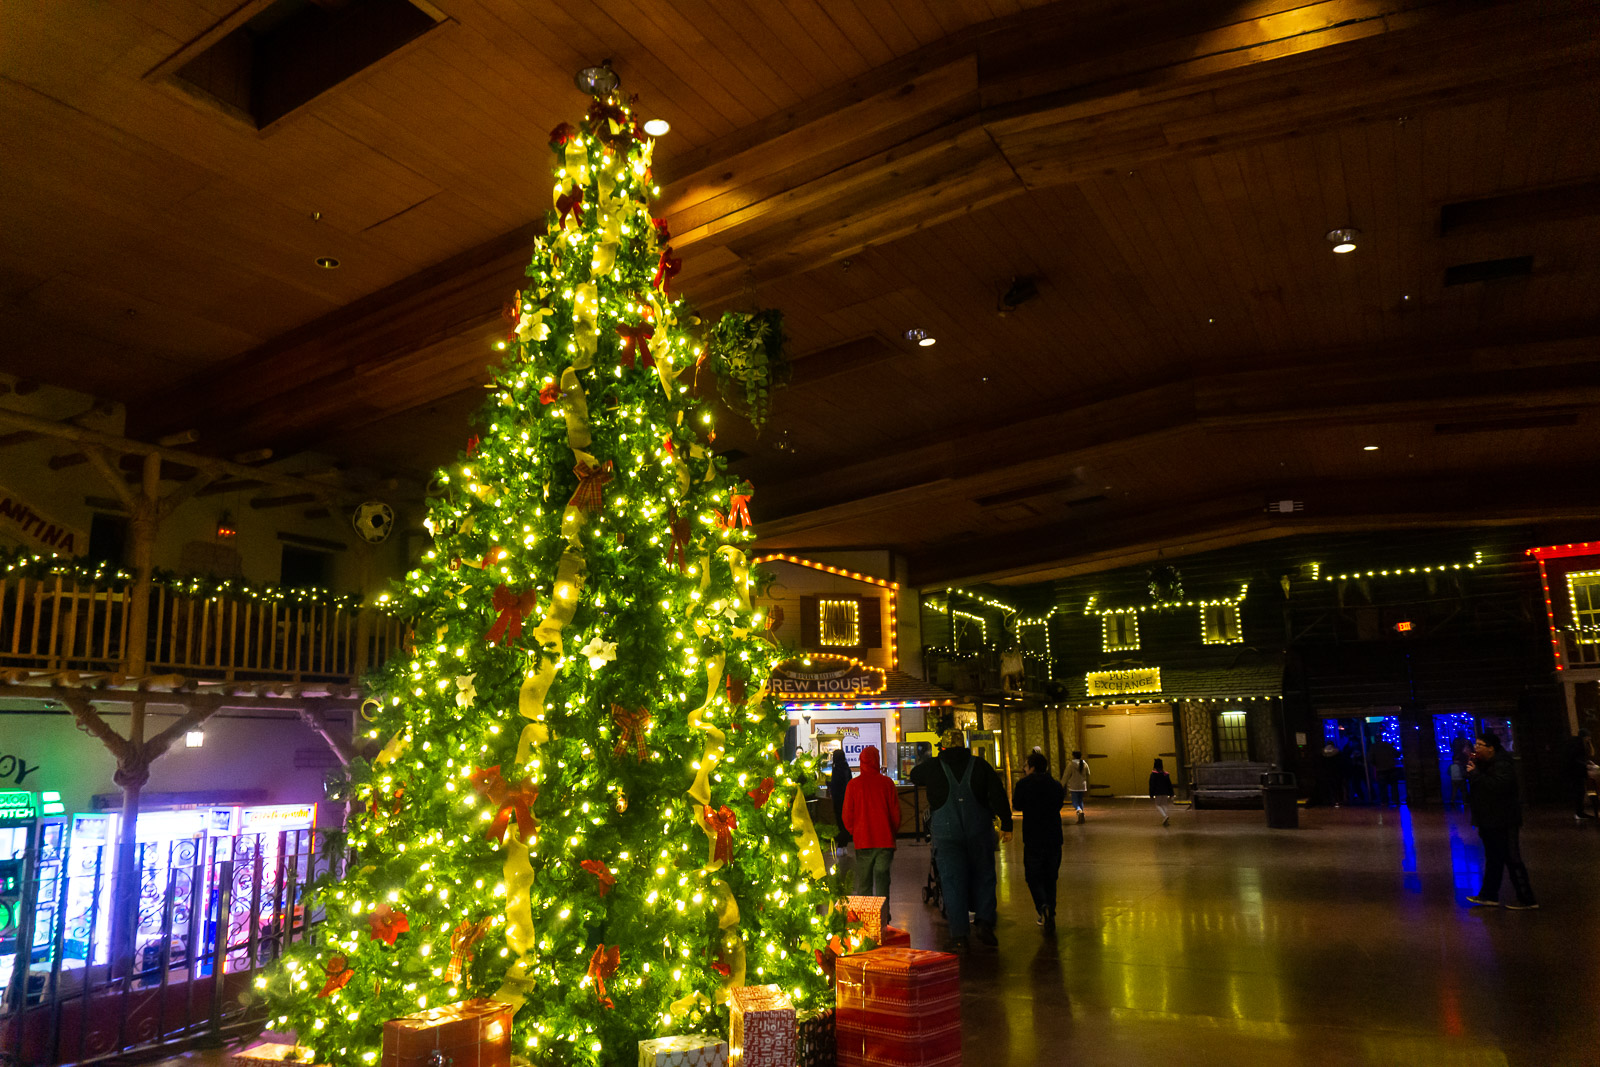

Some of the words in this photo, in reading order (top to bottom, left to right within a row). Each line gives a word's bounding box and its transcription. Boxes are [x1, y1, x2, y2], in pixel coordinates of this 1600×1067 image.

[1109, 672, 1135, 680] POST
[817, 675, 870, 692] HOUSE
[1094, 677, 1153, 691] EXCHANGE
